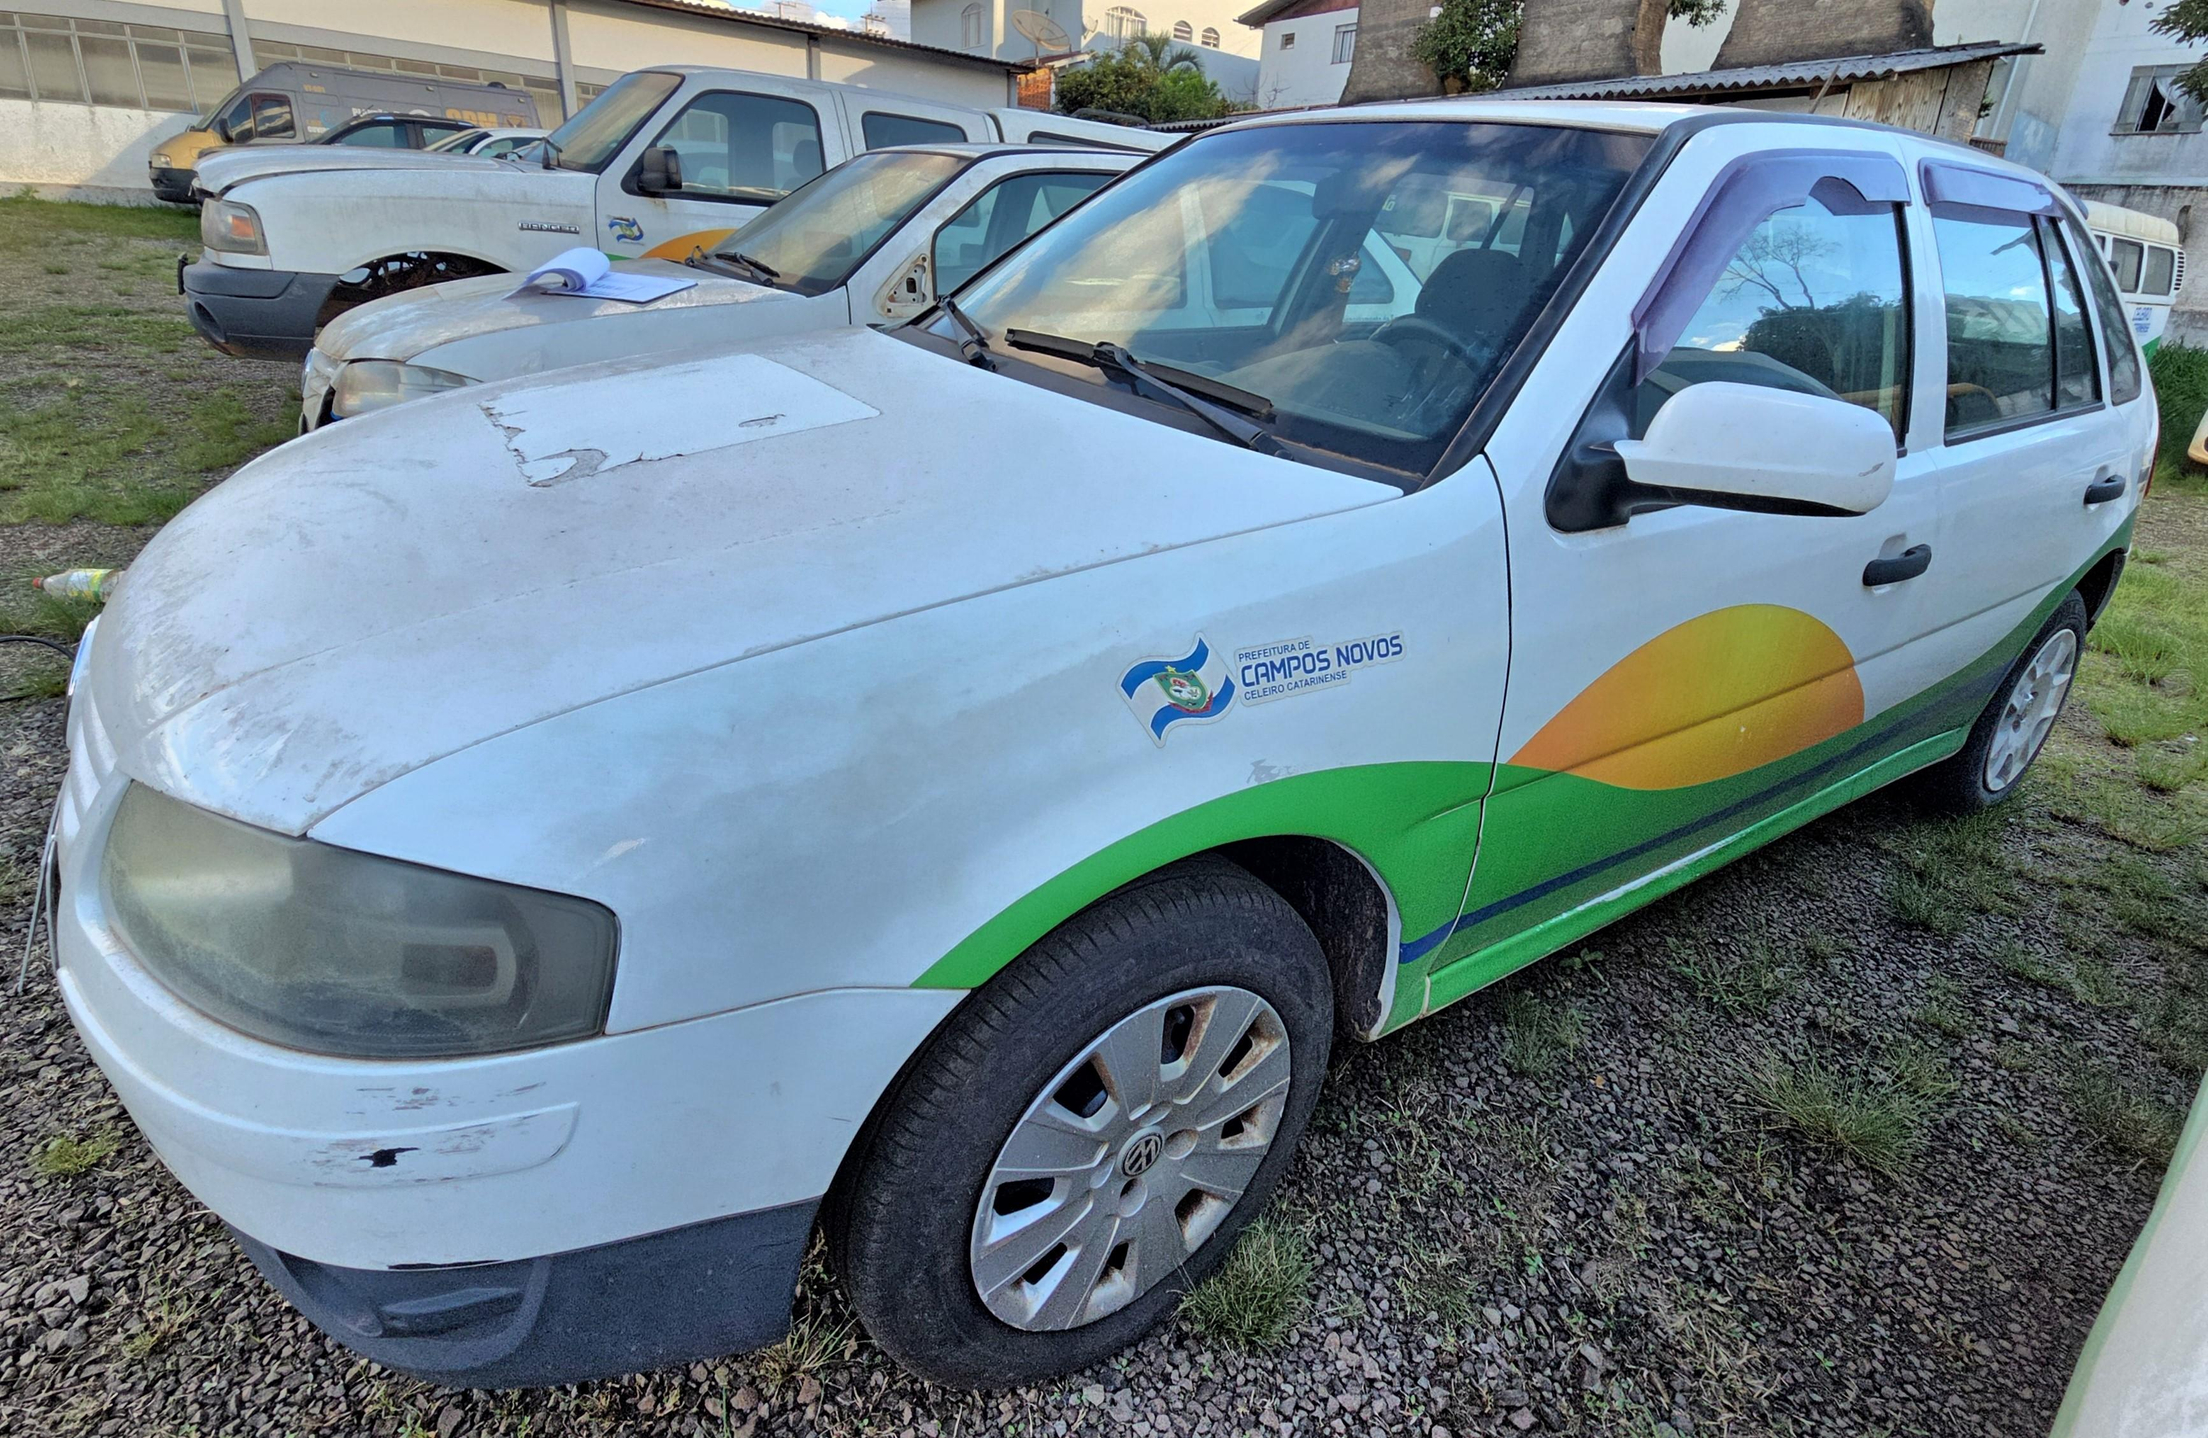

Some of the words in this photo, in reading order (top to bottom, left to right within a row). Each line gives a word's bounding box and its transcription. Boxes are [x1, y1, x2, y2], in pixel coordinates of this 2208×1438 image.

[1238, 643, 1296, 662] PREFEITURA
[1298, 640, 1310, 650] DE
[1241, 649, 1331, 687] CAMPOS
[1335, 634, 1403, 668] NOVOS
[1244, 684, 1285, 701] CELEIRO
[1286, 670, 1347, 692] CATARINENSE
